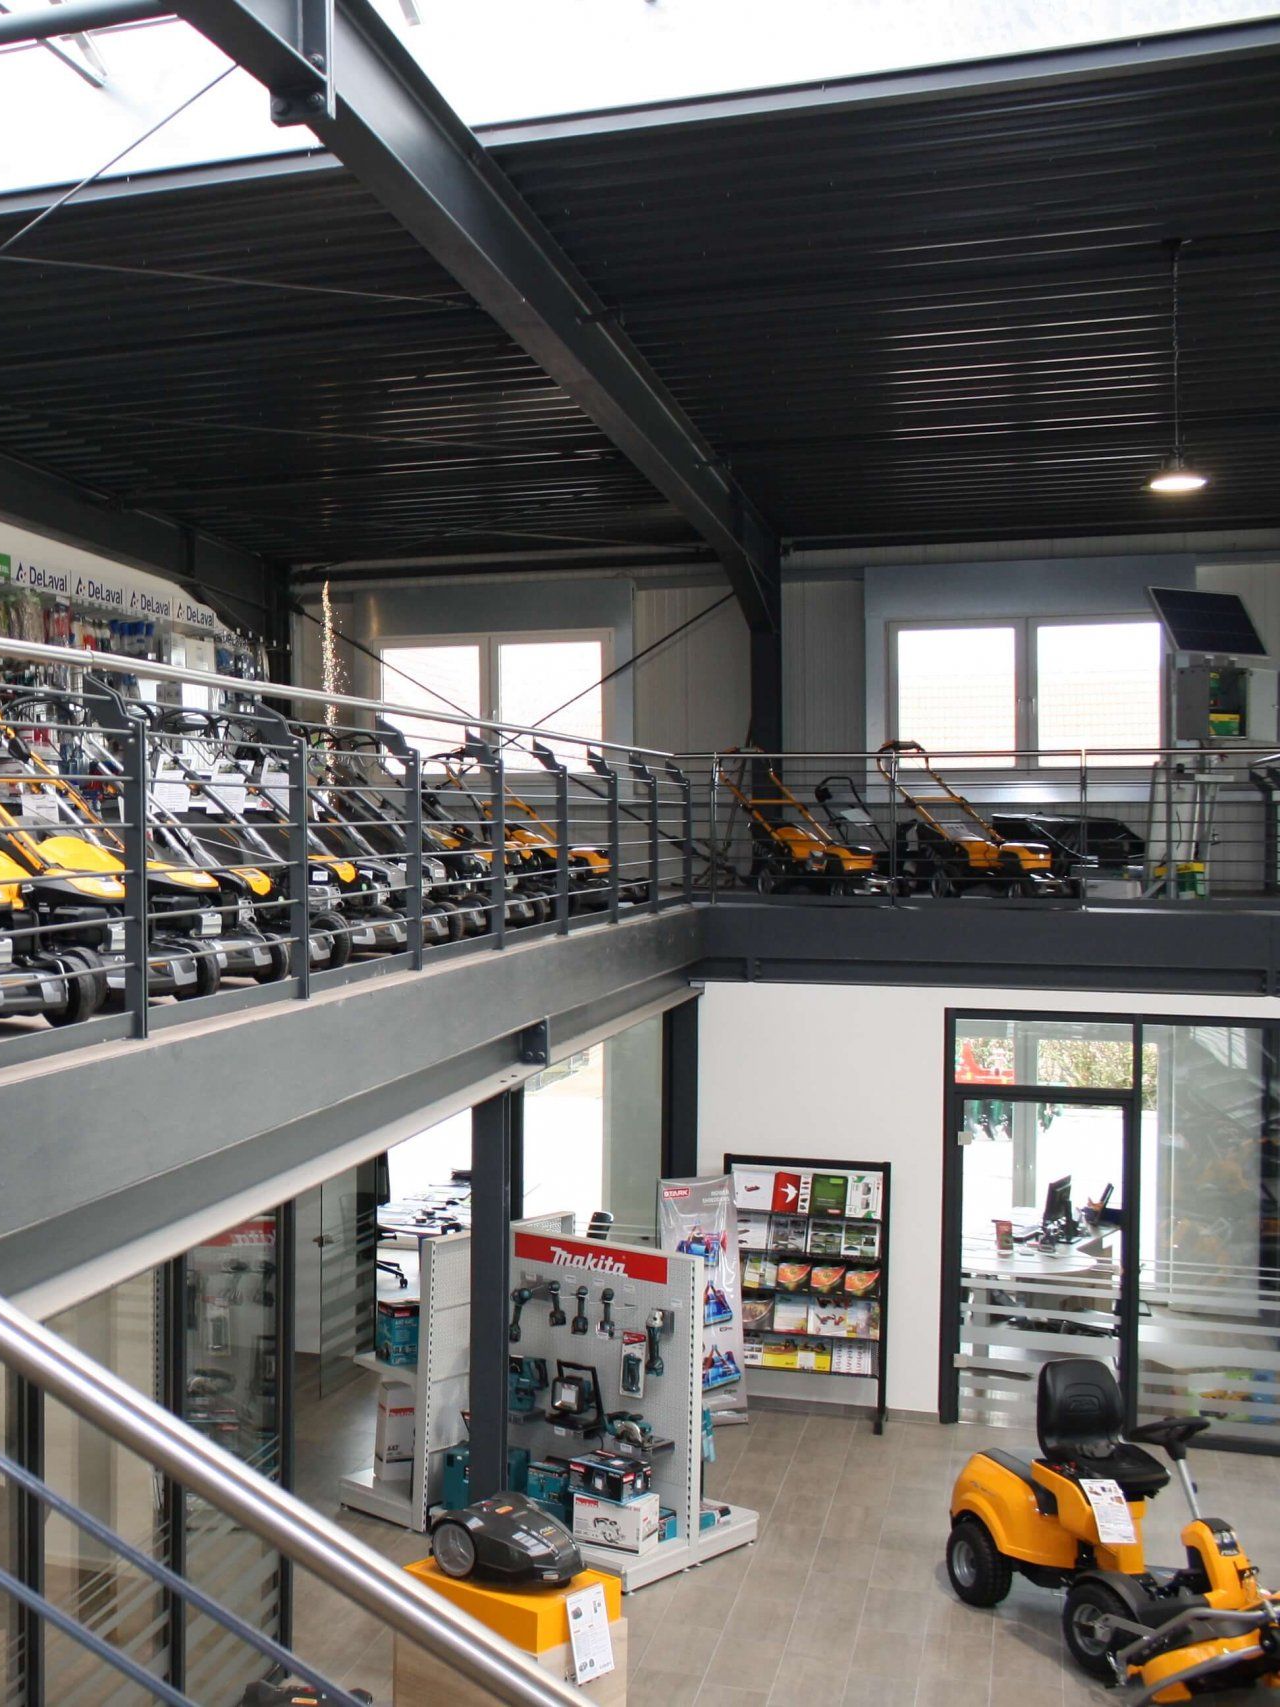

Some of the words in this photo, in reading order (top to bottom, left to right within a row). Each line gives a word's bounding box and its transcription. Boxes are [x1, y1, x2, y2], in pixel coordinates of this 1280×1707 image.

[29, 566, 68, 592] DeLaval
[88, 582, 123, 605] DeLaval
[140, 596, 170, 616] DeLaval
[186, 606, 215, 627] DeLaval
